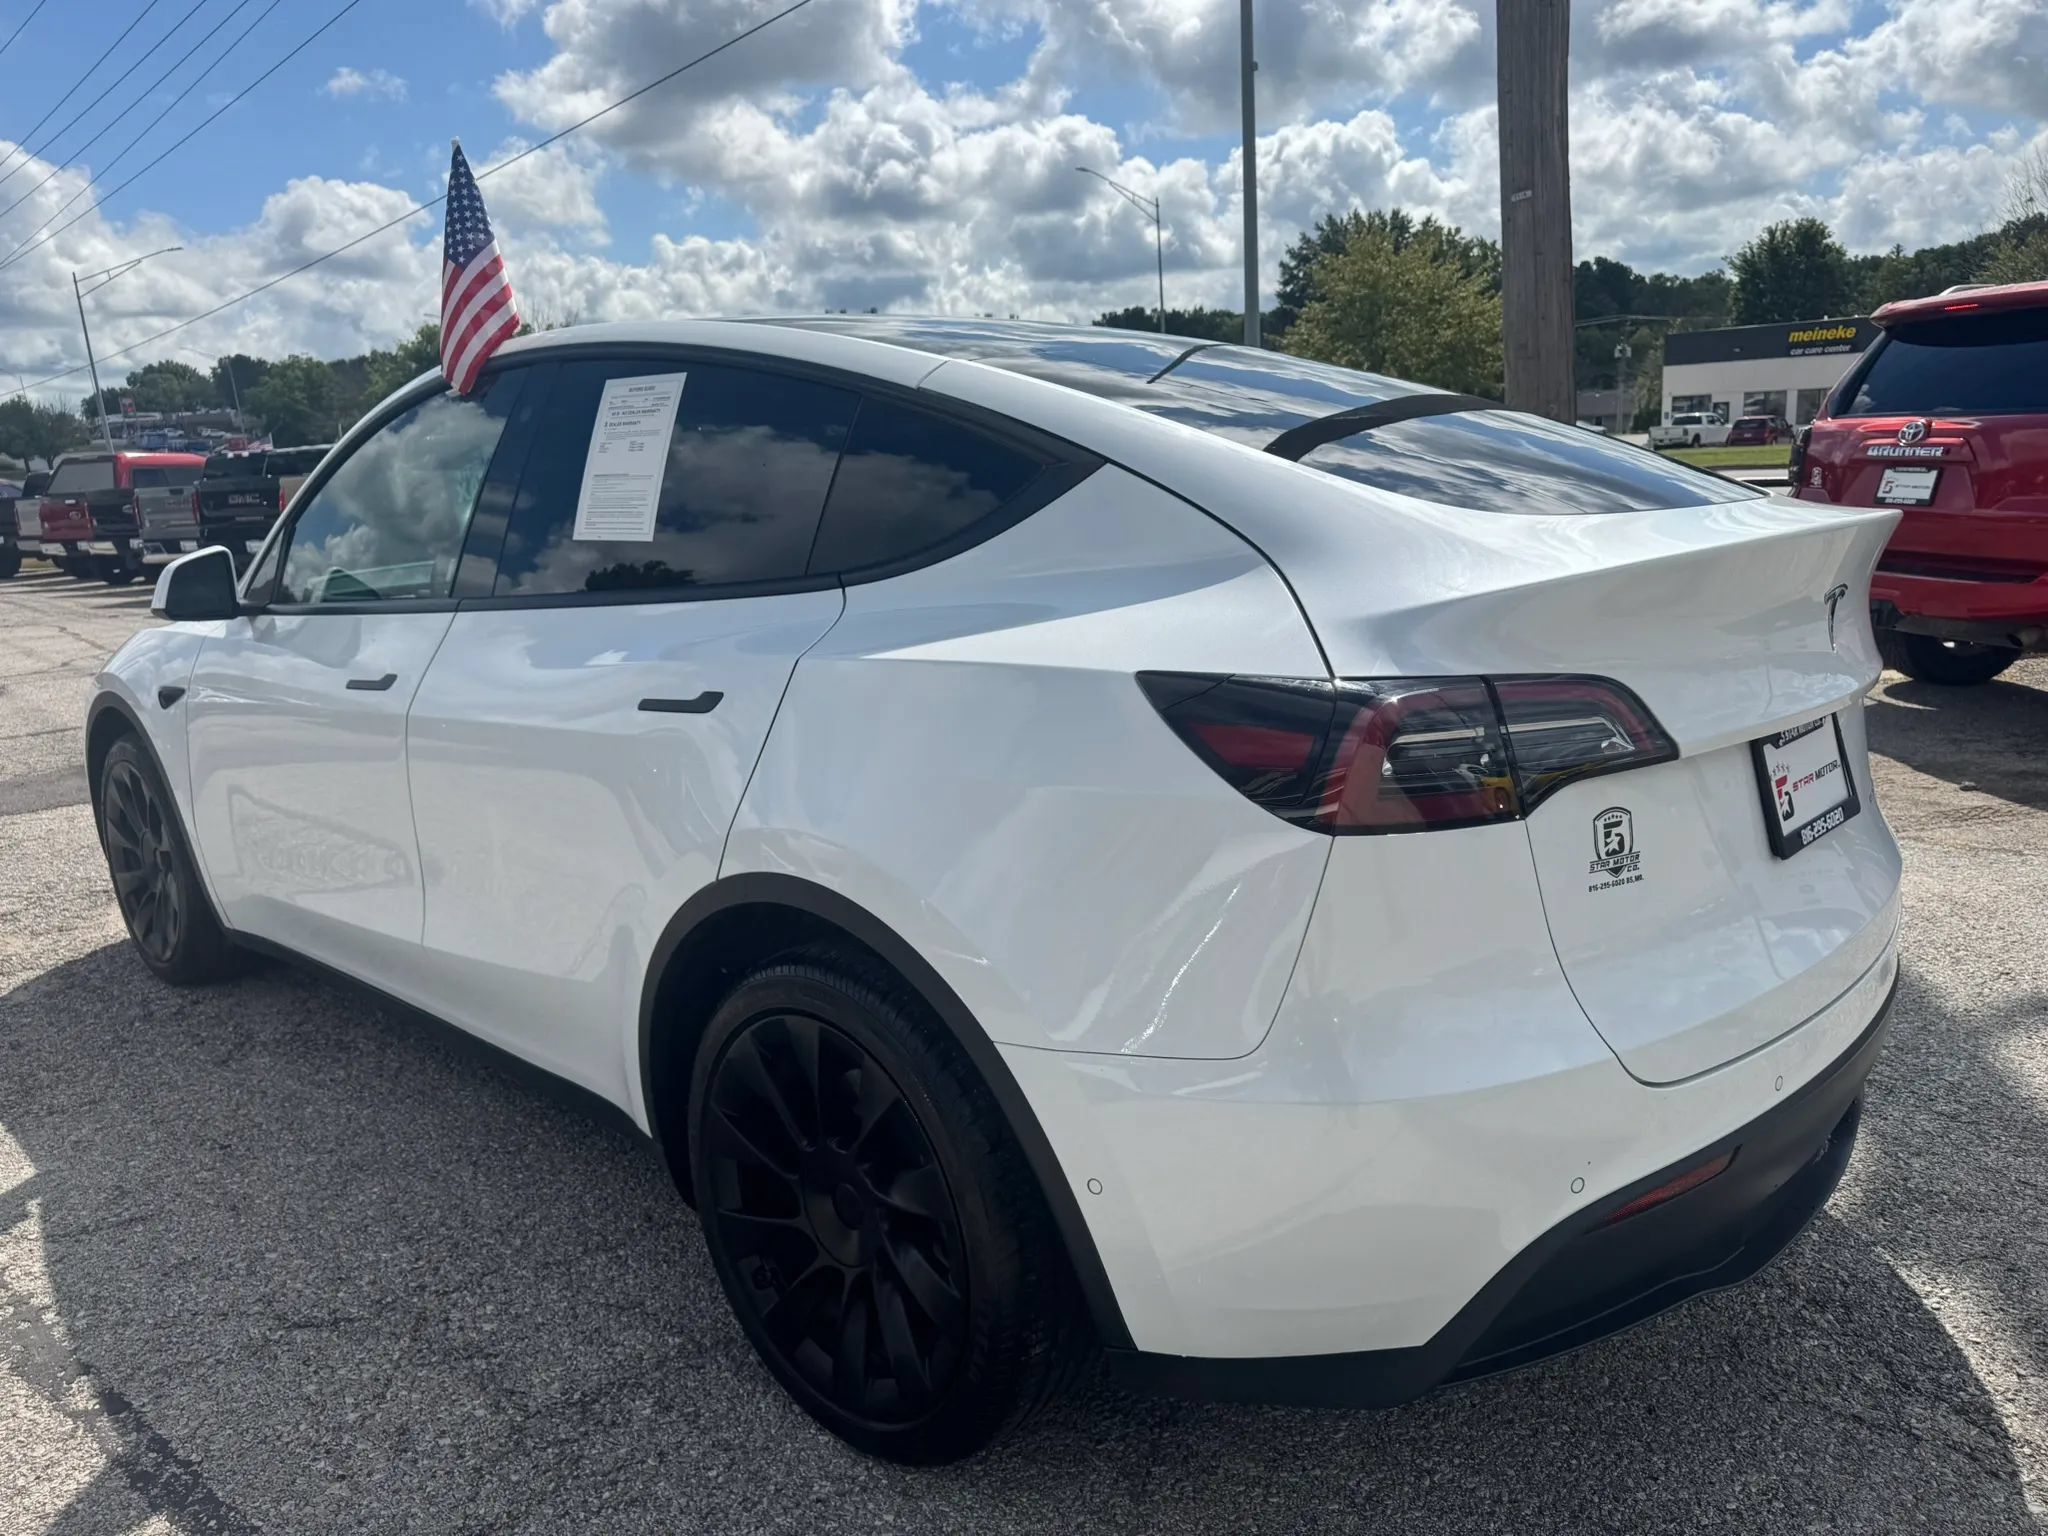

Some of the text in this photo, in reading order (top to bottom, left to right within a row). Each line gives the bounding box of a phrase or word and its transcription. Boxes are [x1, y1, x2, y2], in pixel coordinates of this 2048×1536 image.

[1788, 325, 1857, 342] meineke
[1824, 344, 1851, 353] center
[1866, 446, 1943, 457] 4RUNNER
[1792, 772, 1815, 793] STAR
[1589, 853, 1640, 872] STAR MOTOR
